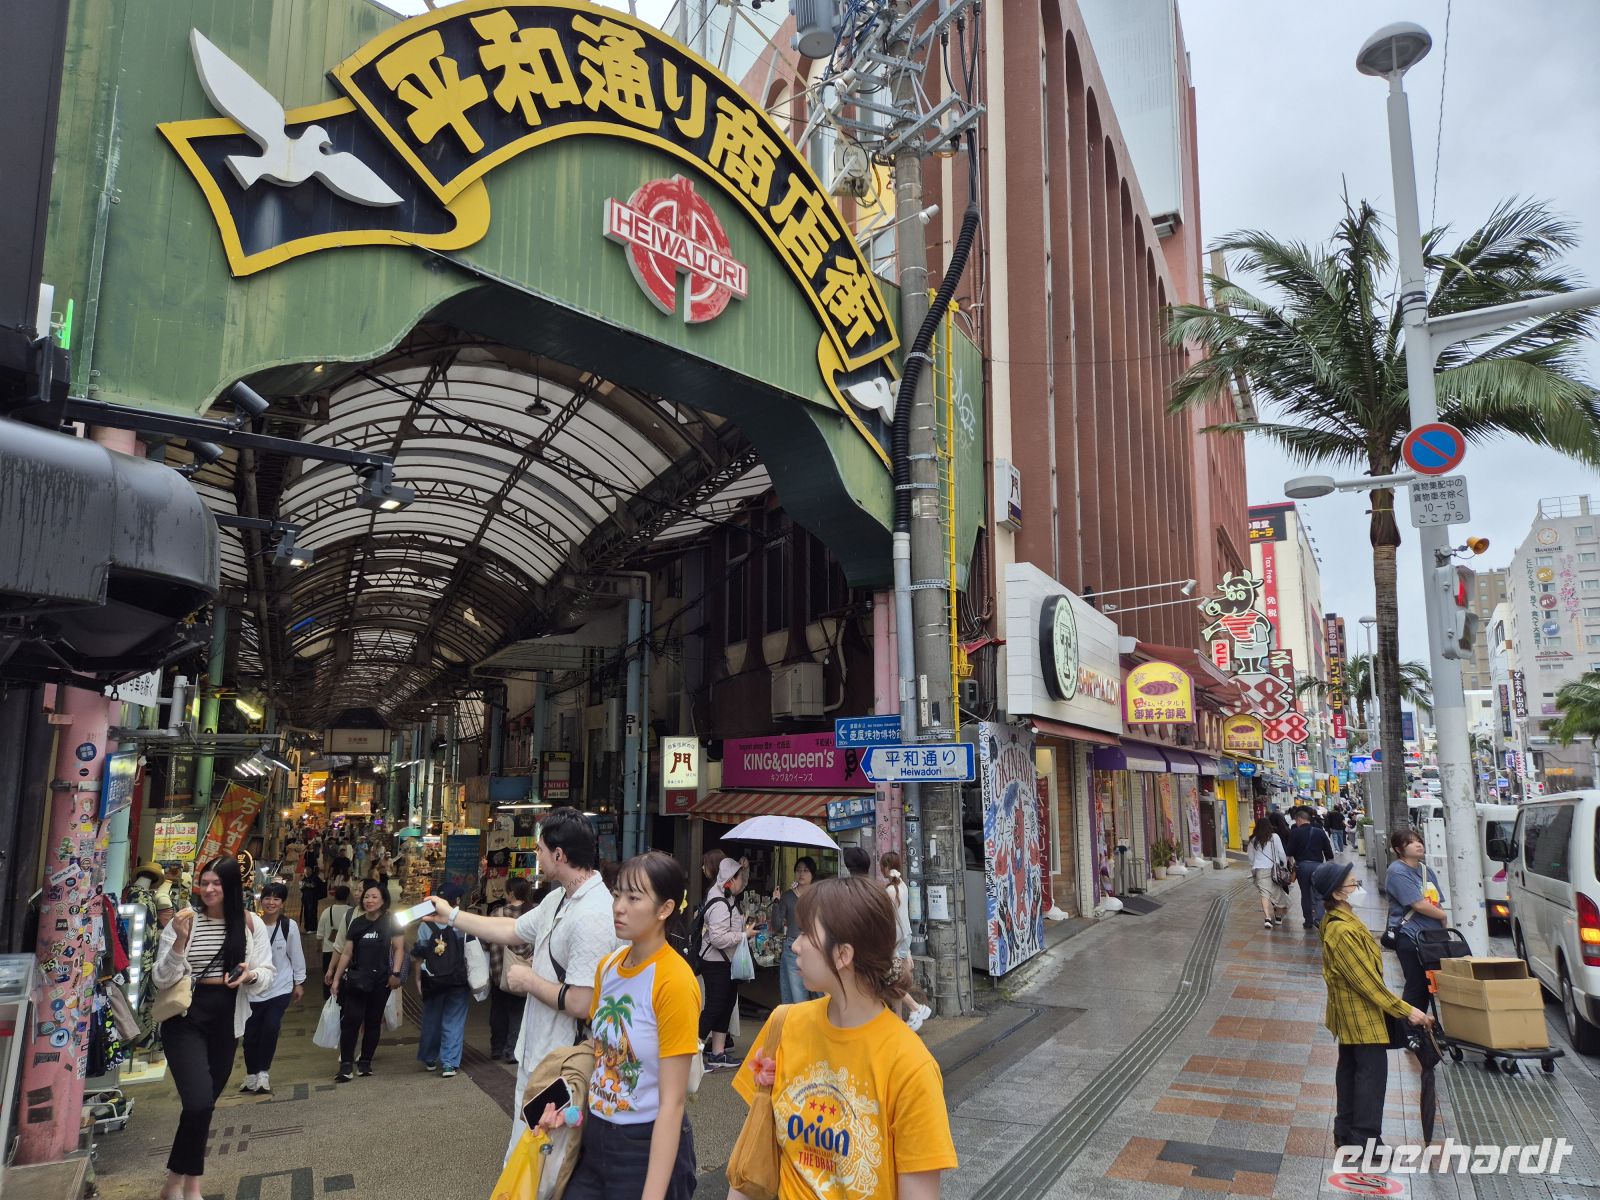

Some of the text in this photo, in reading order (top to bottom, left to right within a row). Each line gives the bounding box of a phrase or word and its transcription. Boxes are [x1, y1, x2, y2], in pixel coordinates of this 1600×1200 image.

[376, 9, 883, 347] 平和通り商店街
[615, 207, 744, 291] HEIWADORI
[1414, 489, 1464, 502] 貨物車を除く
[1419, 512, 1464, 523] ここから
[1134, 708, 1187, 719] 御菓子御殿
[669, 752, 692, 774] 門
[743, 749, 835, 772] KING&queen's
[885, 750, 956, 767] 平和通り
[900, 767, 942, 777] Heiwadori
[787, 1115, 850, 1157] Orion
[798, 1151, 814, 1167] THE
[815, 1155, 837, 1173] DRAFT
